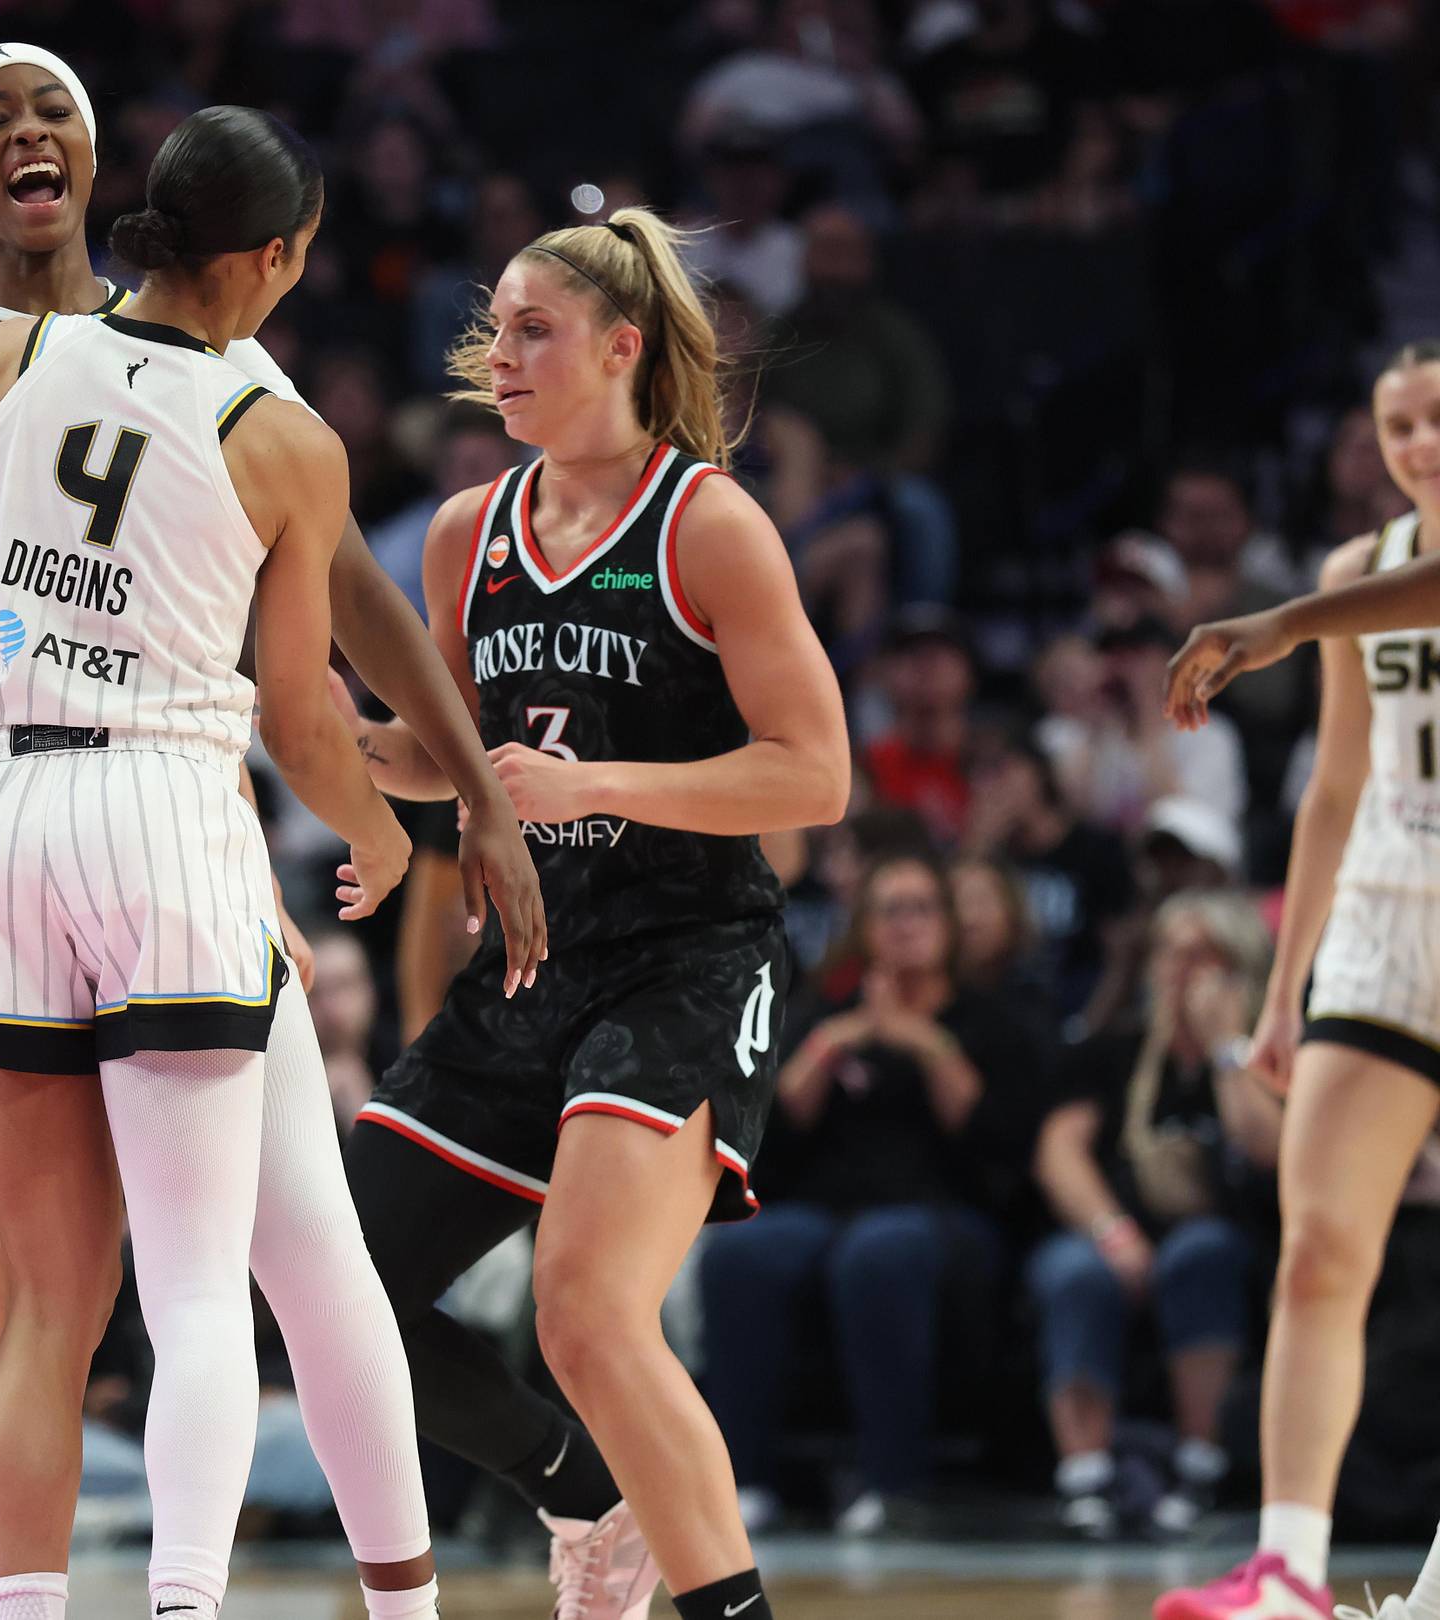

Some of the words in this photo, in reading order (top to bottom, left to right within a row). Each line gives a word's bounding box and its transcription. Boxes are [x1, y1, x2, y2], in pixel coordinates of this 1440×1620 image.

[54, 419, 152, 551] 4
[1, 538, 133, 615] DIGGINS
[591, 568, 653, 590] chime
[31, 632, 140, 686] AT&T
[474, 623, 544, 684] ROSE
[554, 622, 648, 686] CITY
[526, 706, 579, 764] 3
[522, 819, 628, 848] ASHIFY
